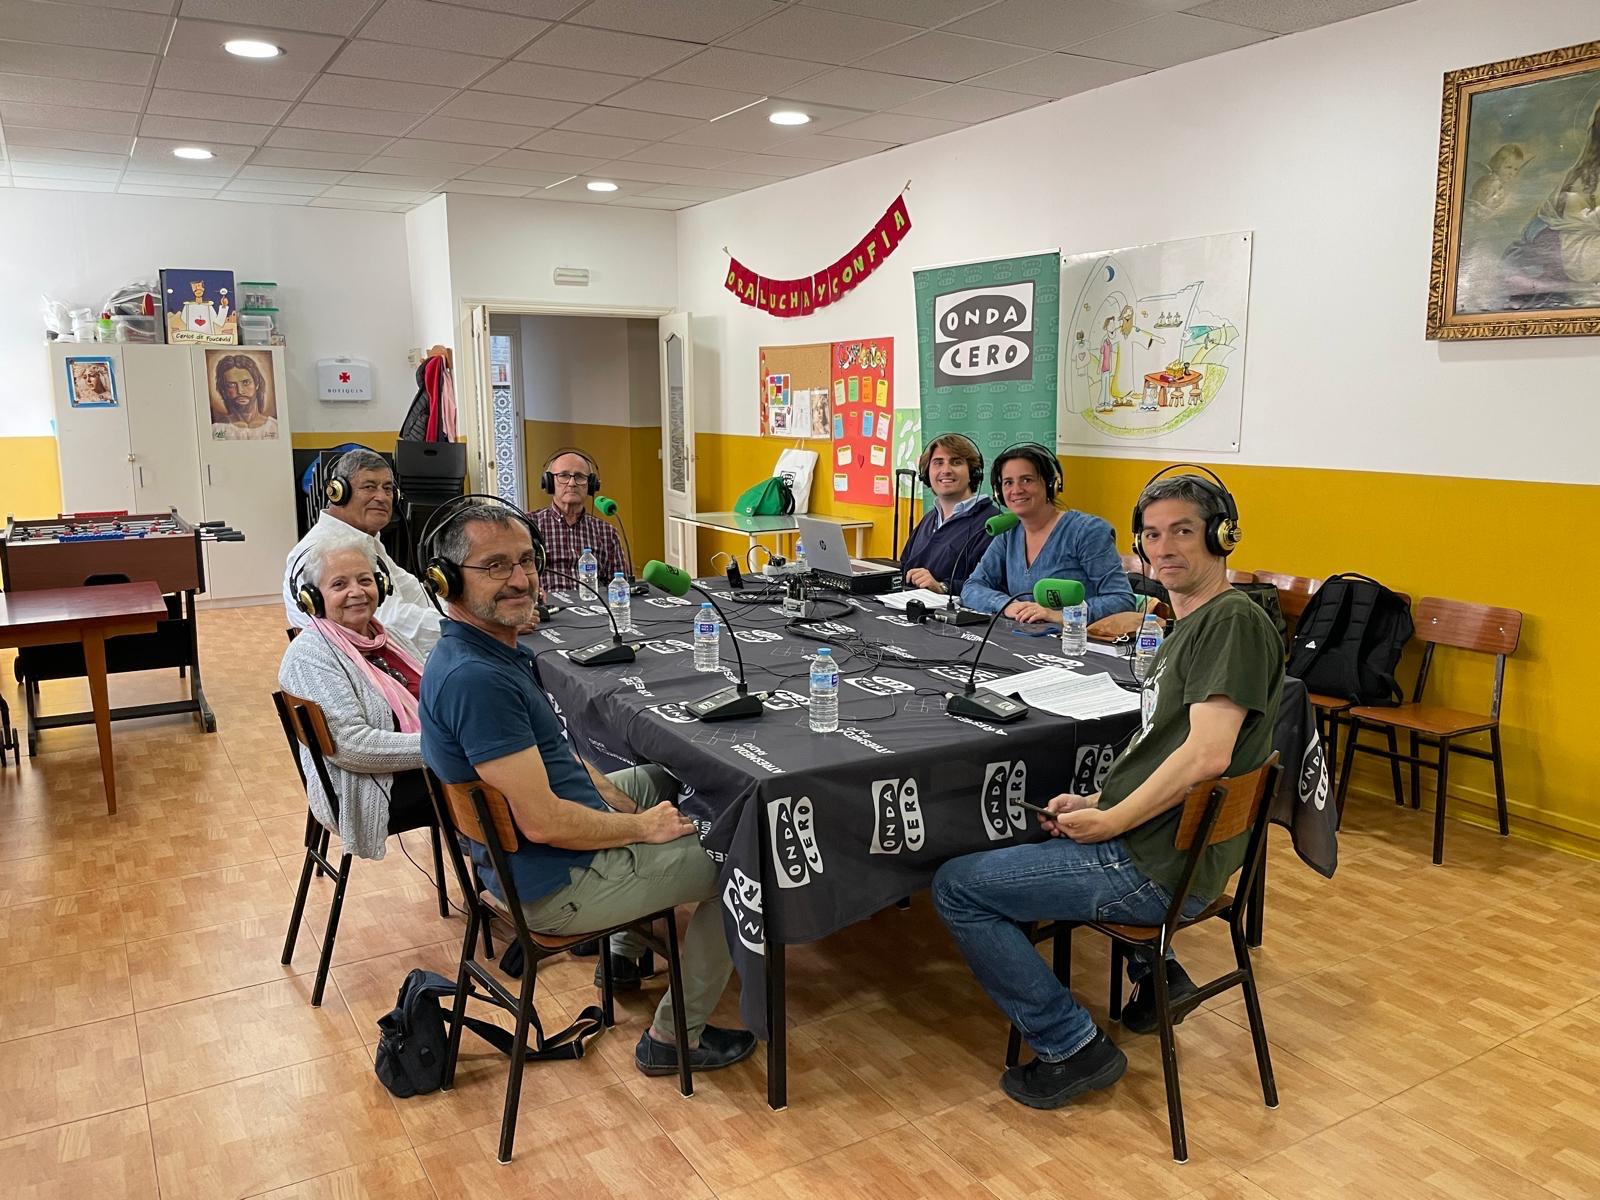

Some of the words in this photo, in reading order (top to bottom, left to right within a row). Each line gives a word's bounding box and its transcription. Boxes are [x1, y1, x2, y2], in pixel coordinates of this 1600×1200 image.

[728, 271, 754, 300] ORA
[760, 289, 810, 310] LUCHA
[817, 283, 826, 302] Y
[832, 209, 905, 294] CONFIA
[946, 305, 1018, 331] ONDA
[951, 344, 1018, 369] CERO
[990, 771, 1005, 829] ONDA
[1079, 756, 1094, 794] NDA
[780, 810, 802, 876] ONDA
[797, 805, 819, 864] CERO
[882, 790, 896, 848] ONDA
[904, 786, 921, 844] CERO
[733, 892, 761, 937] NDA
